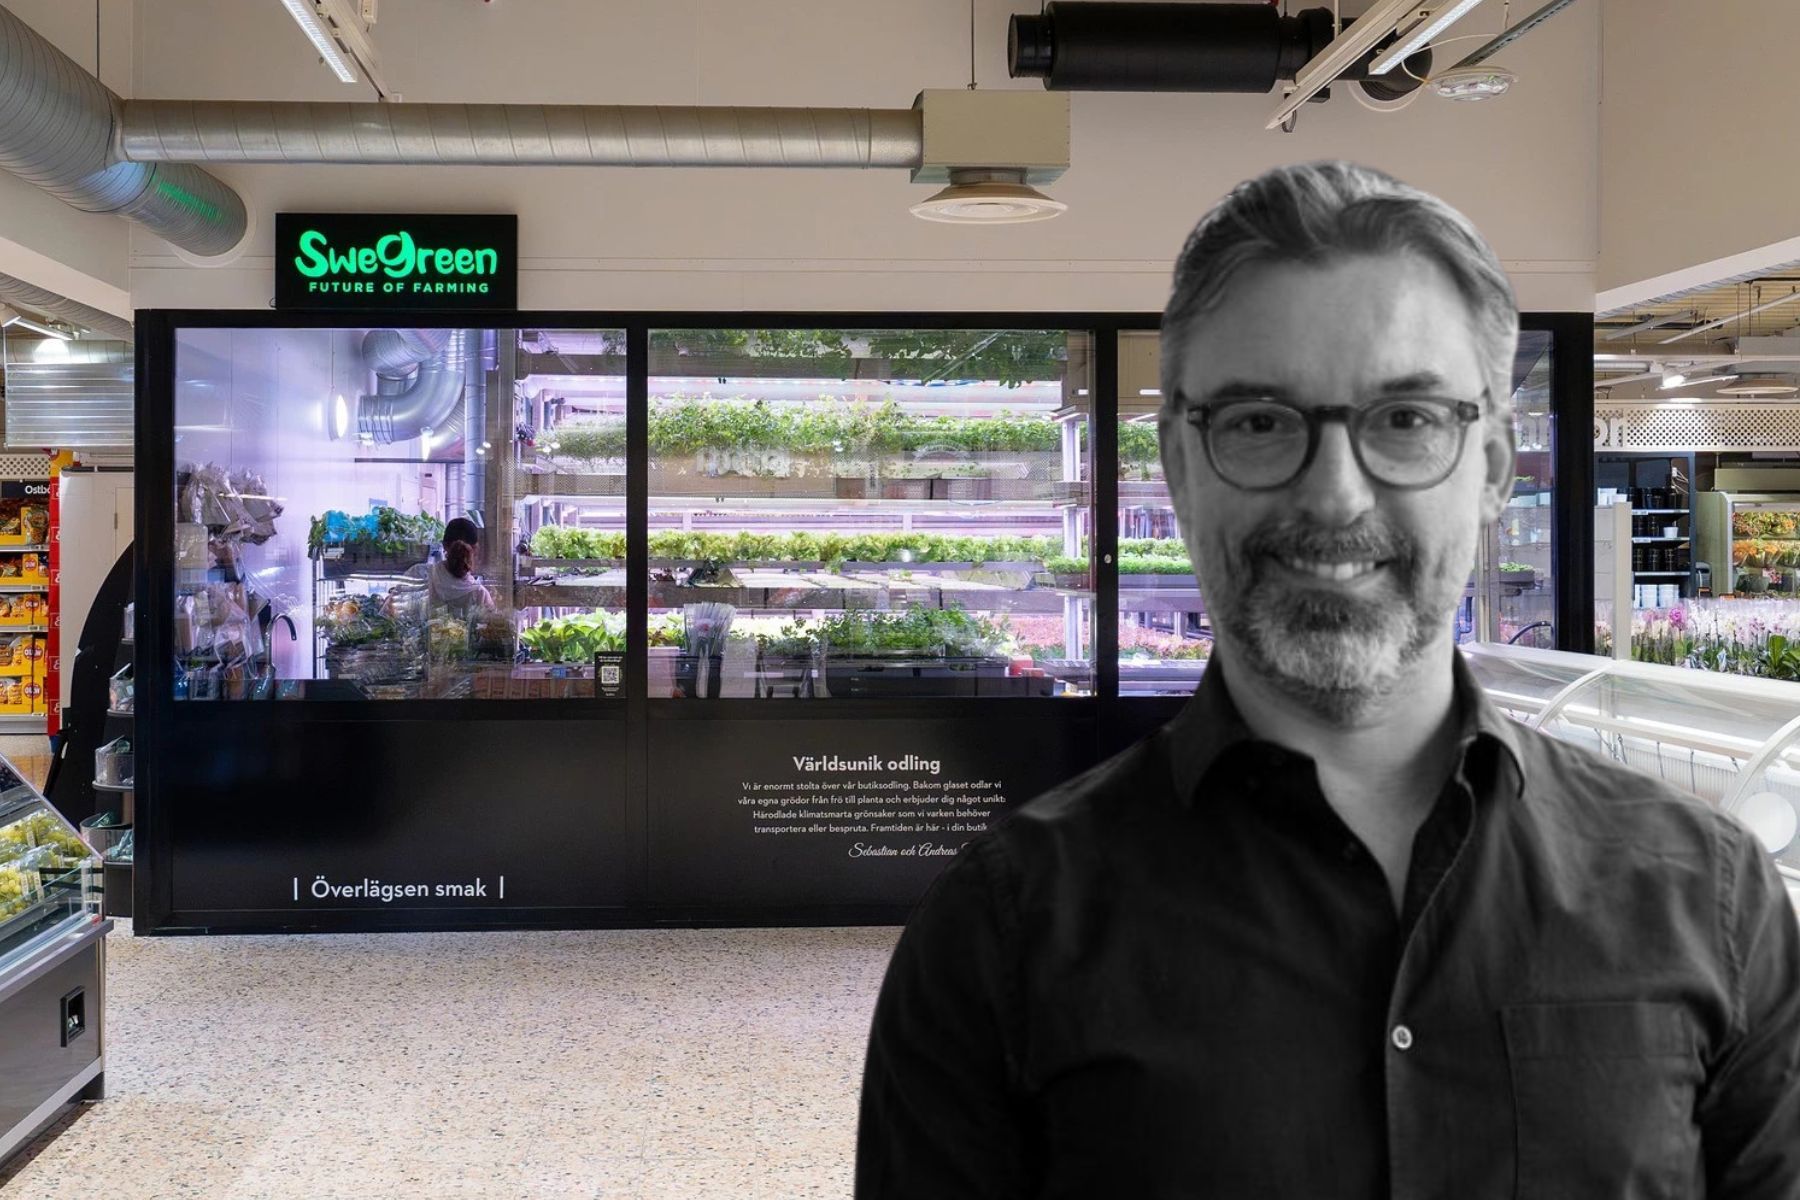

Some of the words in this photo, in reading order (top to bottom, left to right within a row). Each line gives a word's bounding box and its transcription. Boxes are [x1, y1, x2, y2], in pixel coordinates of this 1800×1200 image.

[309, 282, 375, 293] FUTURE
[383, 282, 405, 293] OF
[413, 282, 489, 294] FARMING
[792, 755, 883, 771] Världsunik
[887, 755, 941, 774] odling
[752, 781, 762, 791] är
[763, 783, 795, 791] enormt
[796, 781, 820, 791] stolta
[821, 781, 841, 791] över
[842, 780, 856, 790] vår
[857, 780, 912, 792] butiksodling.
[912, 780, 942, 790] Bakom
[942, 780, 969, 792] glaset
[970, 779, 992, 790] odlar
[994, 779, 1002, 790] vi
[737, 795, 756, 805] våra
[757, 798, 779, 808] egna
[780, 795, 810, 807] grödor
[811, 794, 830, 805] från
[830, 795, 844, 804] frö
[844, 795, 856, 804] till
[857, 794, 884, 806] planta
[885, 794, 902, 804] och
[902, 794, 939, 806] erbjuder
[940, 794, 955, 806] dig
[956, 794, 981, 805] något
[752, 809, 798, 819] Härodlade
[798, 809, 853, 819] klimatsmarta
[853, 809, 896, 820] grönsaker
[917, 809, 925, 818] vi
[926, 808, 955, 818] varken
[956, 808, 991, 818] behöver
[754, 824, 807, 835] transportera
[807, 823, 827, 833] eller
[829, 823, 869, 834] bespruta.
[870, 822, 914, 833] Framtiden
[915, 823, 924, 832] är
[925, 823, 940, 832] här
[951, 822, 965, 832] din
[848, 842, 899, 858] Sebastian
[900, 844, 916, 856] och
[918, 842, 958, 857] Andreas
[311, 875, 429, 902] Överlägsen
[435, 877, 487, 897] smak
